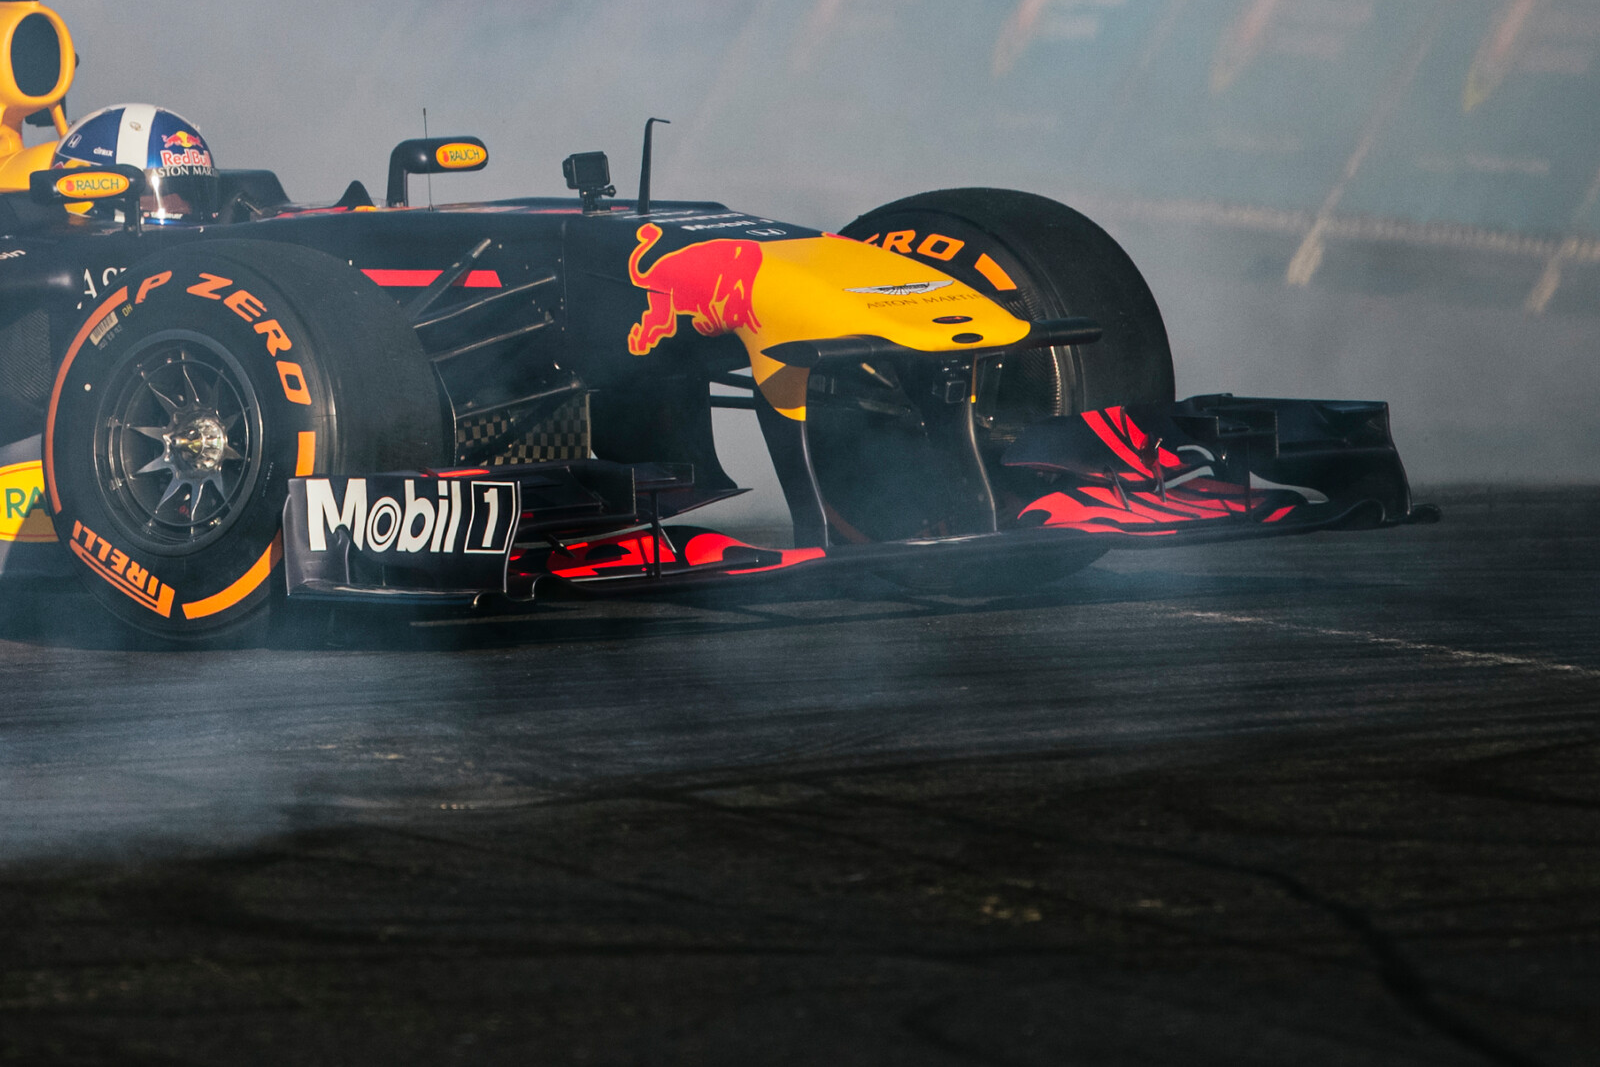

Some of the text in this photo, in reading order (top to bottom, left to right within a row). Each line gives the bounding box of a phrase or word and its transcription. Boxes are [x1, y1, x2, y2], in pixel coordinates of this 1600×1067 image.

[448, 148, 481, 162] RAUCH
[75, 178, 120, 191] RAUCH
[865, 297, 918, 310] ASTON
[135, 270, 313, 406] P ZERO
[305, 478, 463, 553] Mobil
[69, 519, 177, 619] PIRELLI
